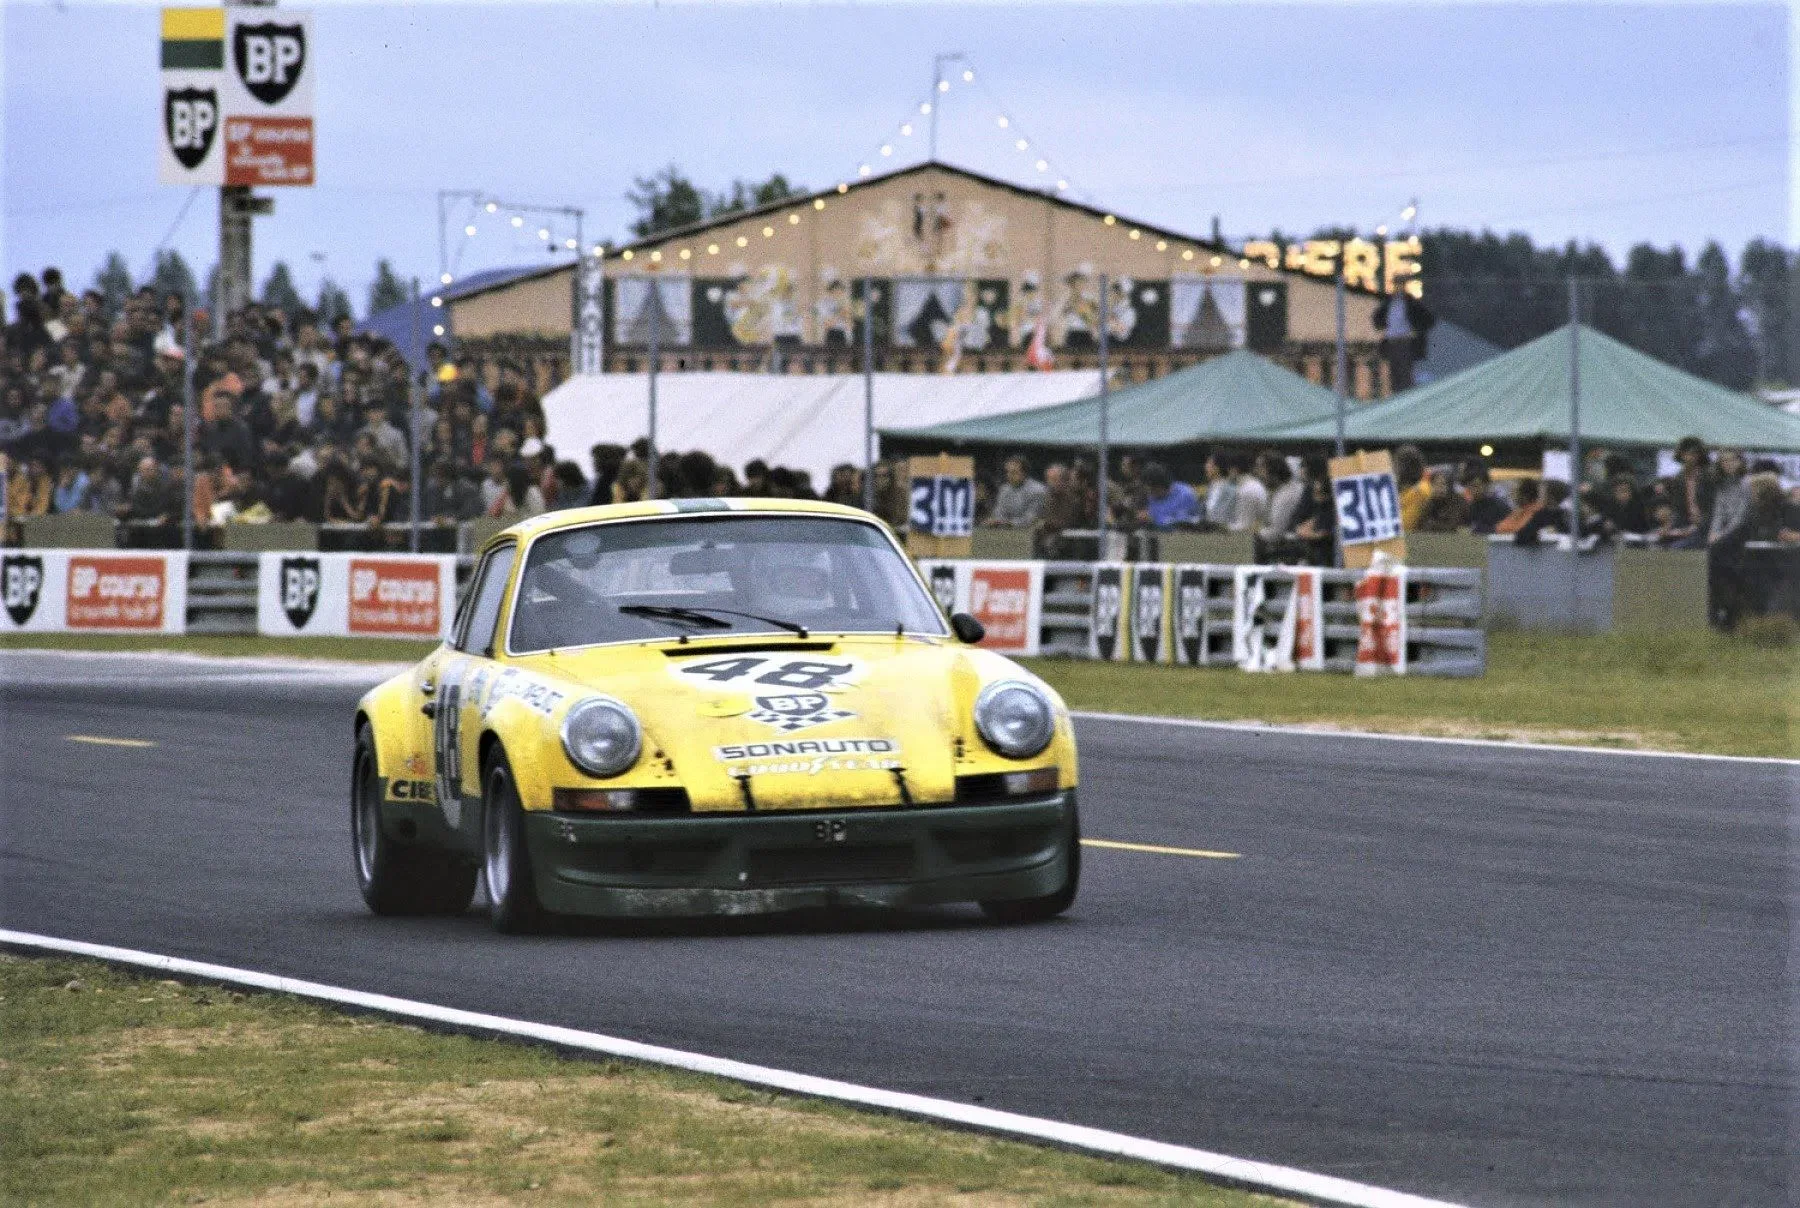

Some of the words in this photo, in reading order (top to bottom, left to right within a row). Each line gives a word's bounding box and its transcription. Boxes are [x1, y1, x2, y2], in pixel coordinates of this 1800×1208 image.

[246, 36, 300, 84] BP
[173, 101, 214, 149] BP
[1336, 474, 1399, 540] 3M
[6, 566, 42, 607] BP
[286, 568, 318, 610] BP
[680, 656, 854, 689] 48
[769, 693, 826, 713] BP
[720, 738, 893, 760] SONAUTO
